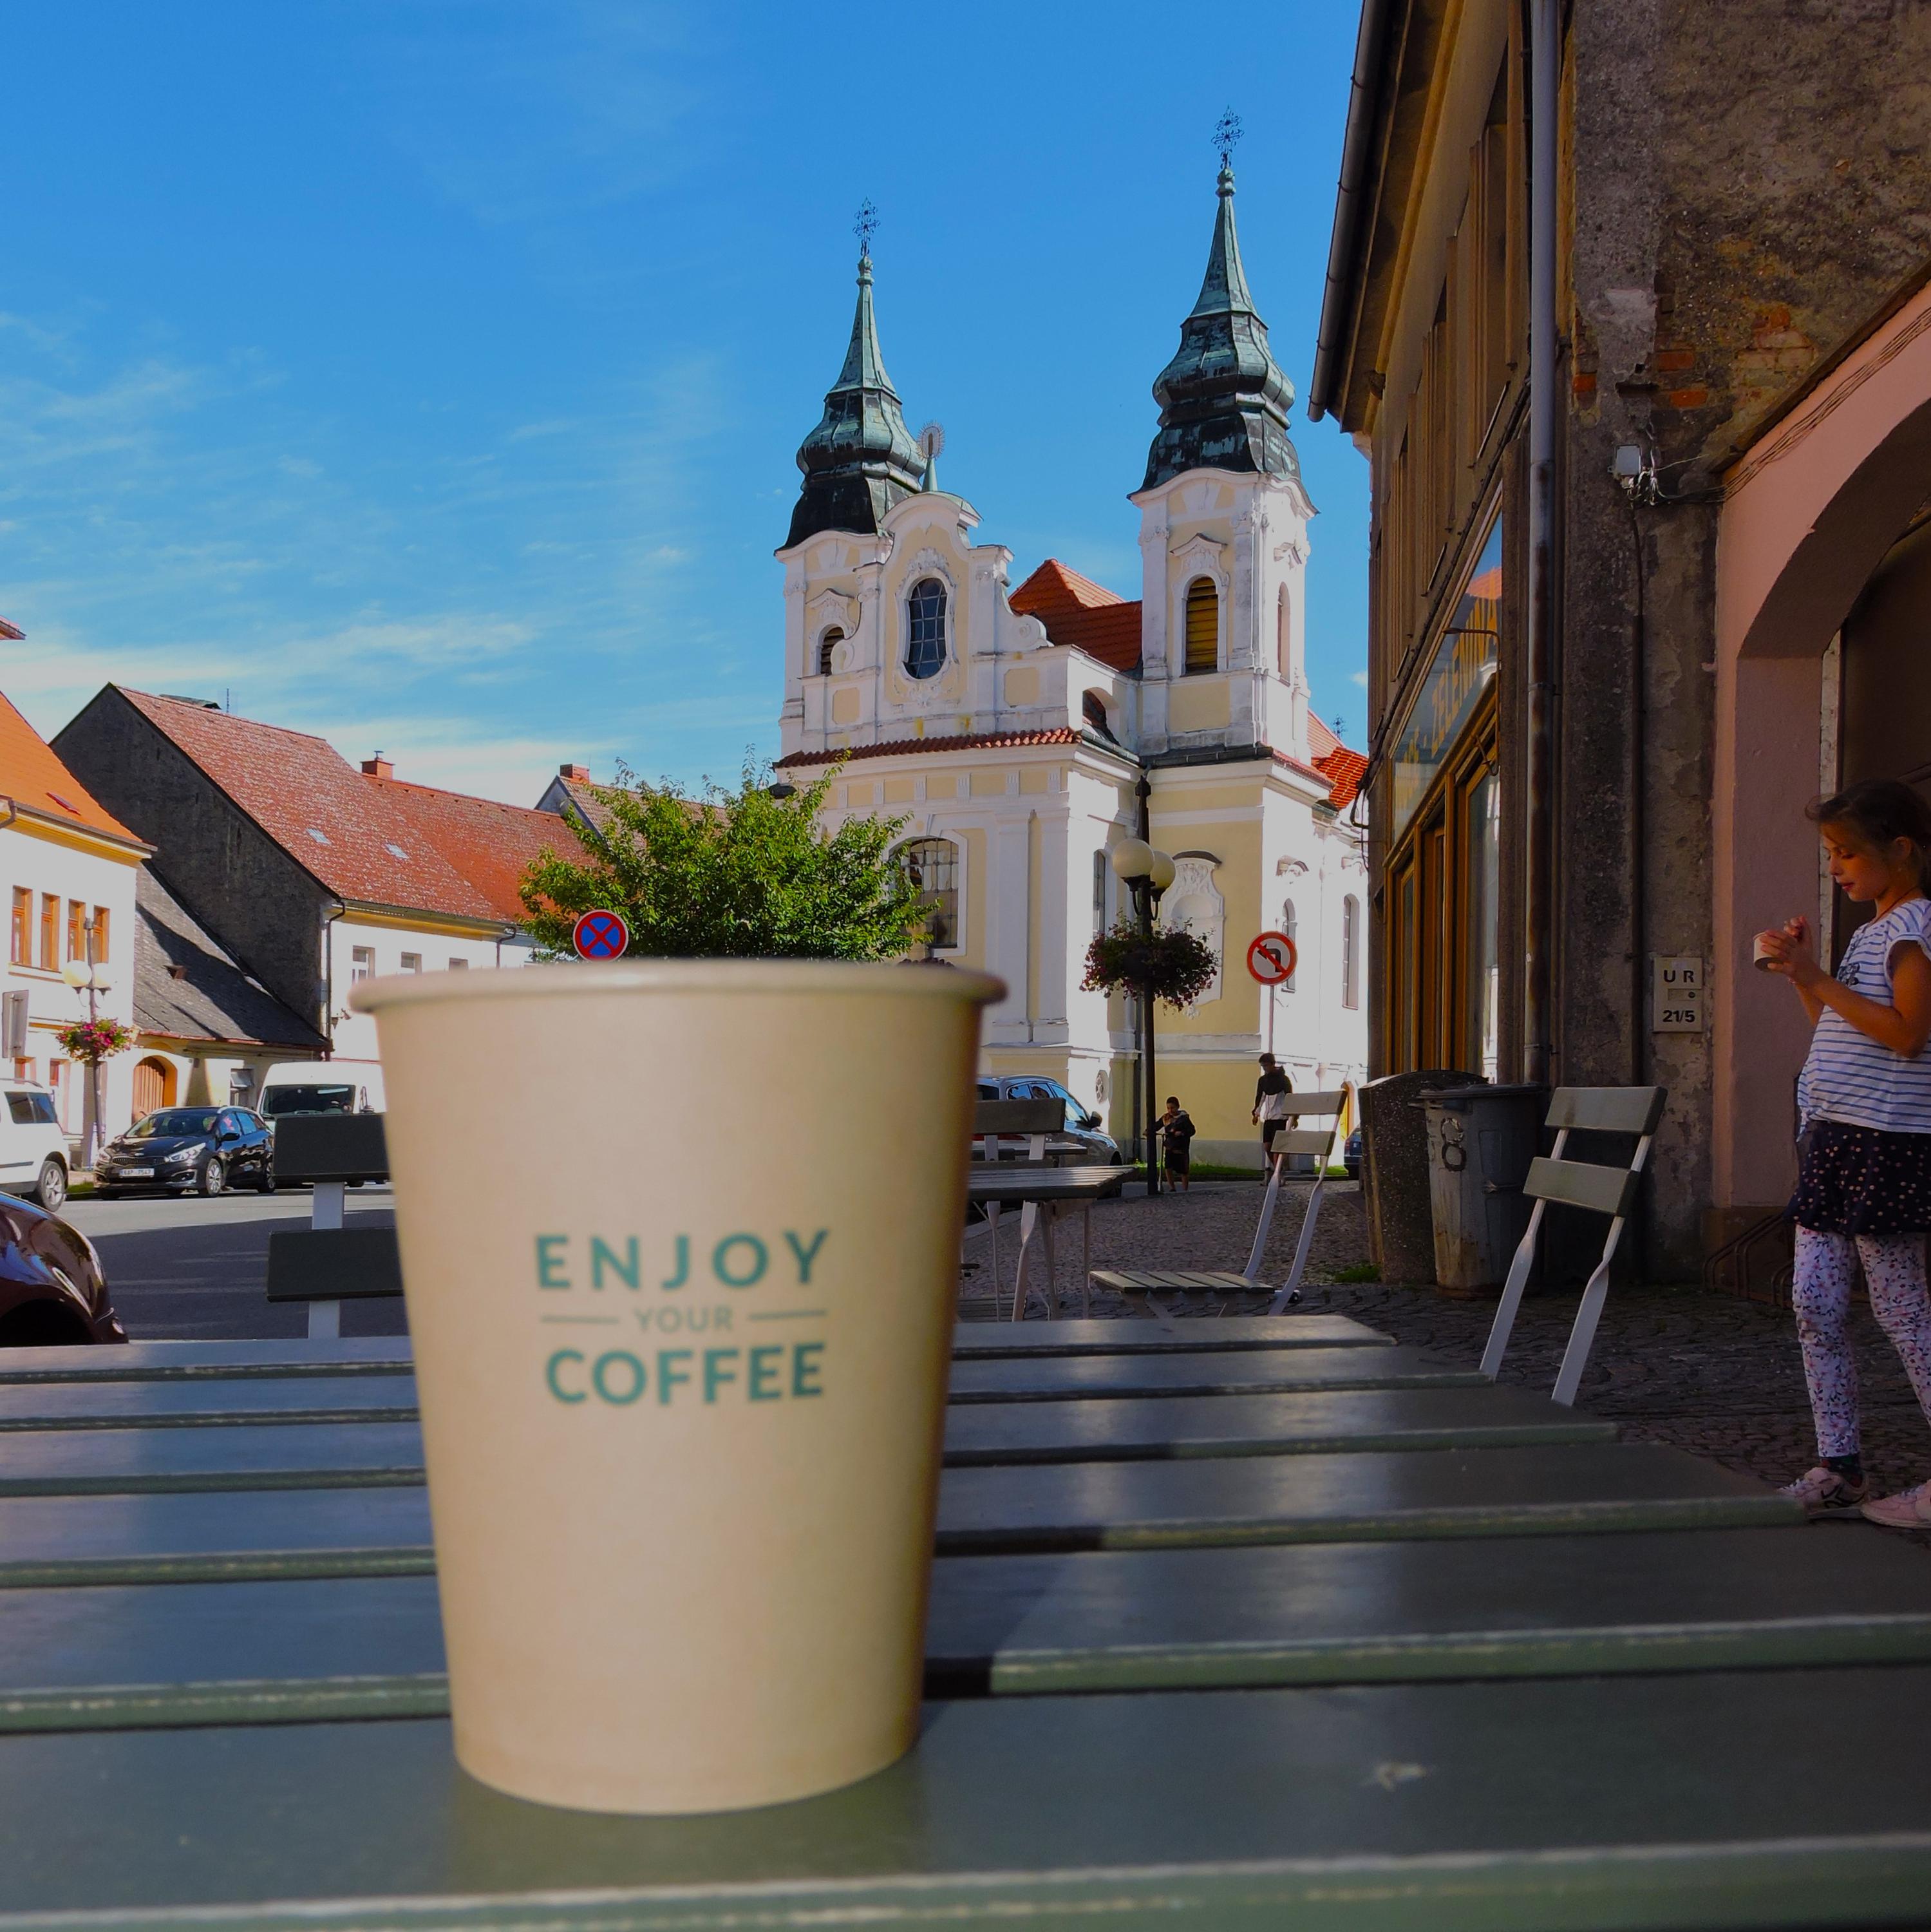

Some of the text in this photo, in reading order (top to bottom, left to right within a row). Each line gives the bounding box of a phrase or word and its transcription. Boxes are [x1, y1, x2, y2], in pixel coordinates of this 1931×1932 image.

[1662, 1009, 1695, 1023] 21/5
[535, 1227, 829, 1291] ENJOY
[633, 1305, 734, 1334] YOUR
[545, 1341, 825, 1406] COFFEE
